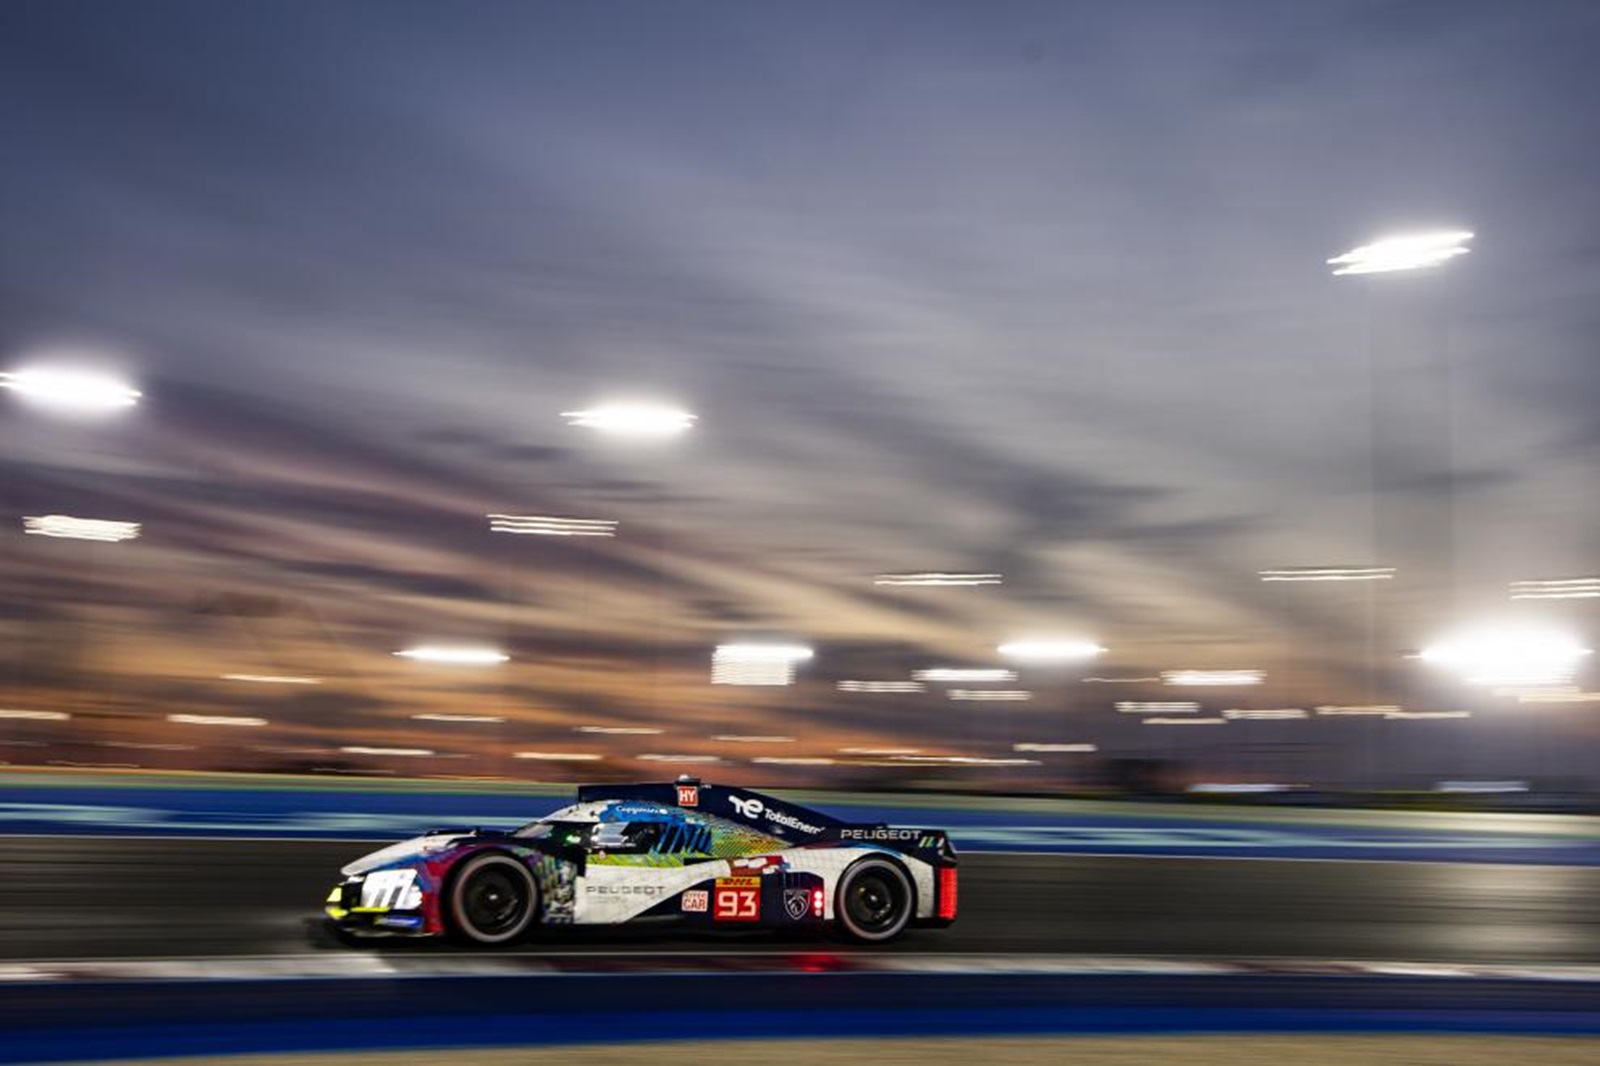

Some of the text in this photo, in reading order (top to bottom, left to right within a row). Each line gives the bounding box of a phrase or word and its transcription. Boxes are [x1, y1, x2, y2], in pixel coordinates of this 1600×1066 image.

[680, 789, 696, 802] HY
[840, 829, 921, 840] PEUGEOT
[722, 878, 753, 886] DHL
[585, 886, 666, 895] PEUGEOT
[683, 899, 706, 909] CAR
[718, 891, 756, 916] 93
